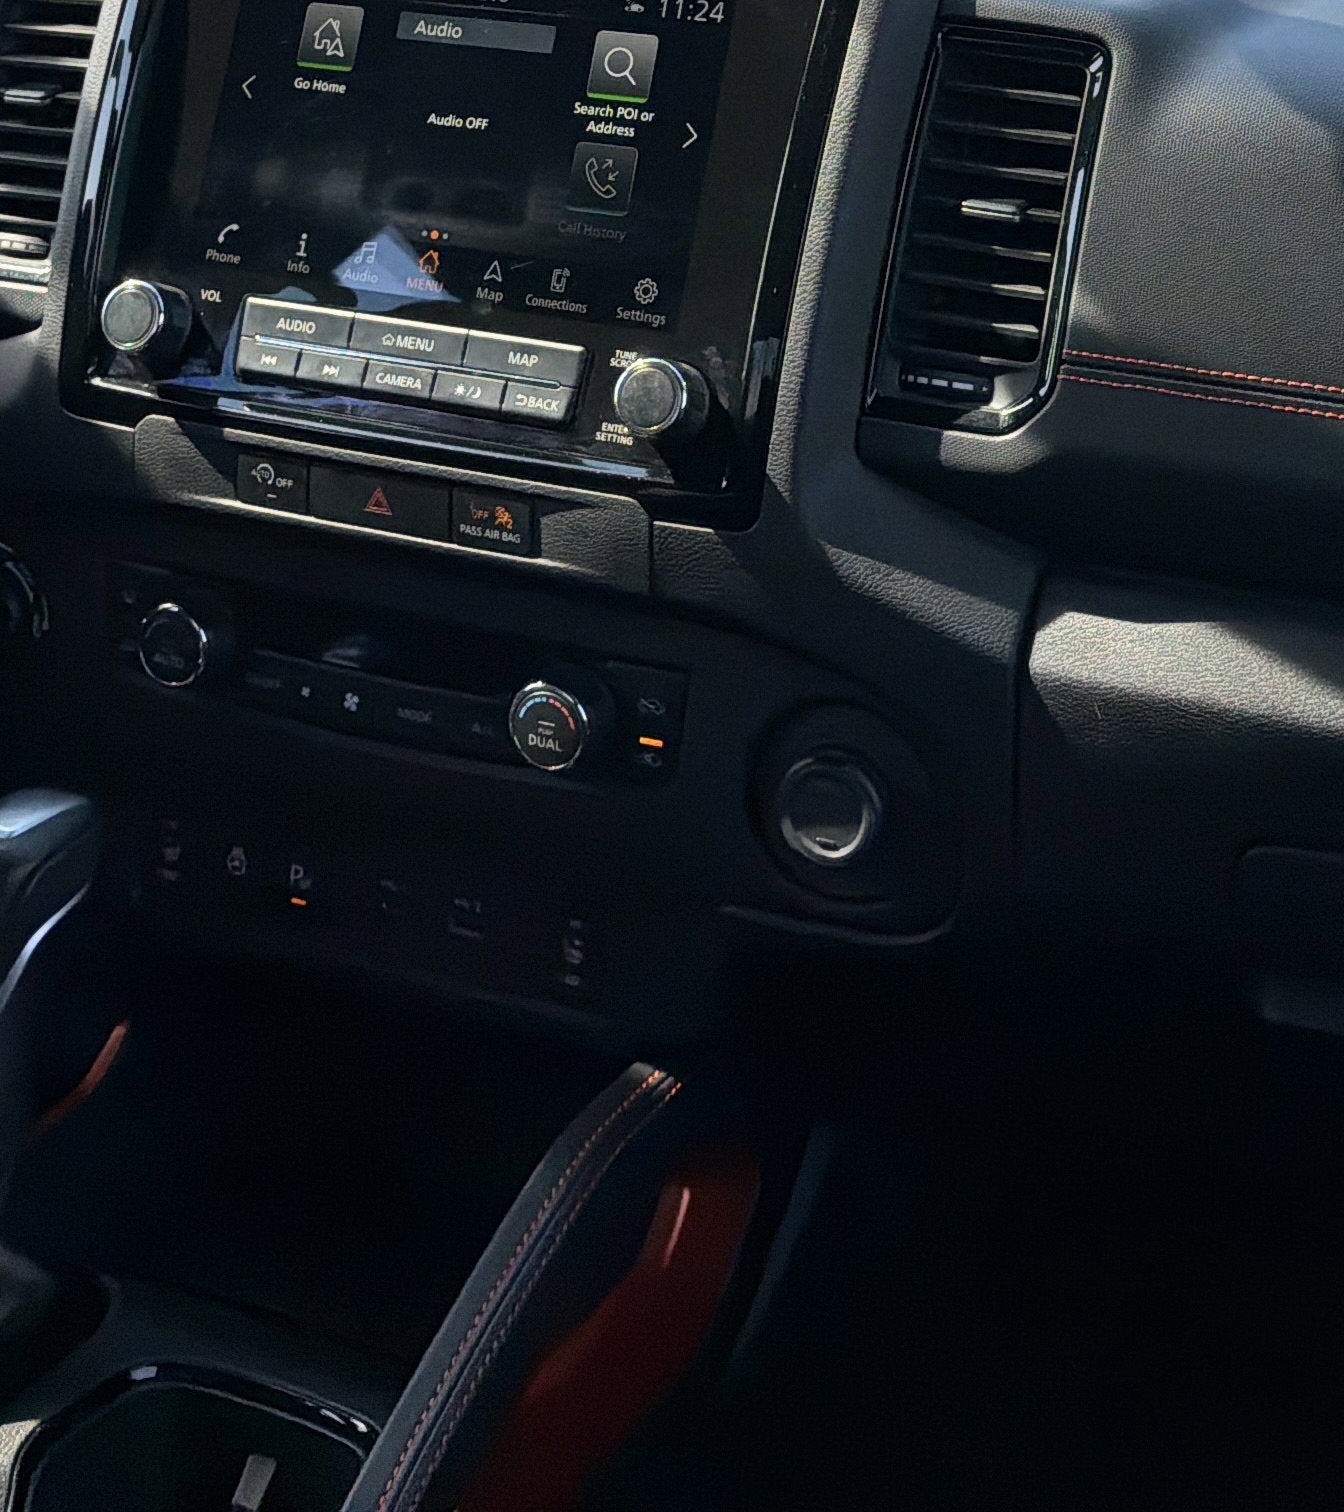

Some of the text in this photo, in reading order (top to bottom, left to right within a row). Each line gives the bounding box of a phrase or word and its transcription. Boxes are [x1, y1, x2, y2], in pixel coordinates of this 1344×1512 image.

[414, 20, 463, 40] Audio
[294, 77, 347, 94] Go Home
[573, 101, 655, 123] Search POI or
[427, 113, 490, 131] Audio OFF
[586, 120, 636, 138] Address
[206, 249, 241, 265] Phone
[286, 259, 311, 275] Info
[342, 268, 379, 284] Audio
[406, 277, 444, 294] MENU
[200, 289, 223, 303] VOL
[476, 287, 504, 305] Map
[525, 293, 588, 315] Connections
[616, 306, 666, 327] Settings
[276, 317, 316, 335] AUDIO
[396, 334, 435, 352] MENU
[508, 351, 539, 367] MAP
[616, 349, 638, 361] TUNE
[376, 372, 423, 390] CAMERA
[526, 396, 560, 413] BACK
[595, 431, 634, 446] SETTING
[276, 477, 294, 488] OFF
[459, 523, 521, 544] PASS AIR BAG
[528, 733, 563, 753] DUAL
